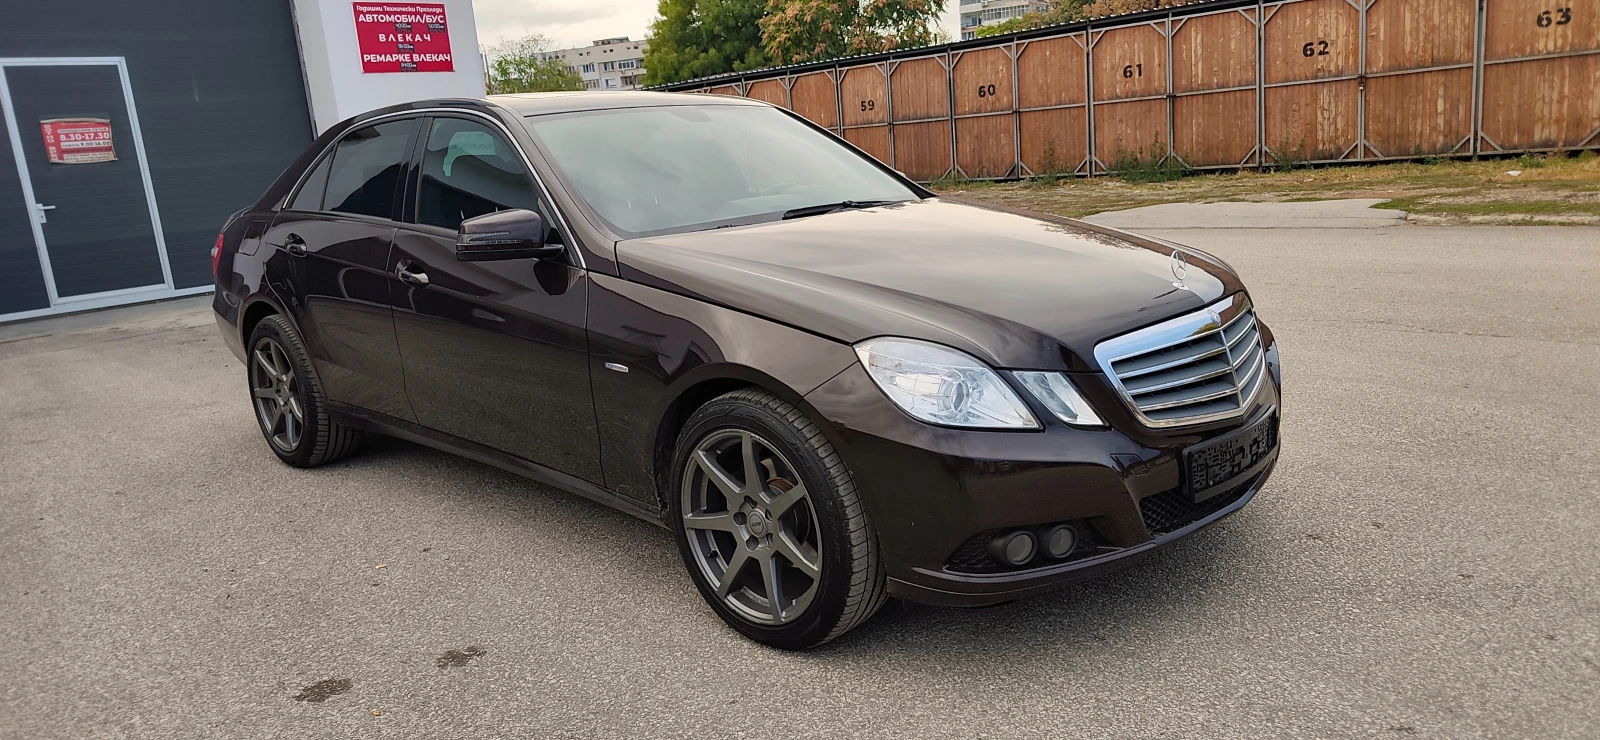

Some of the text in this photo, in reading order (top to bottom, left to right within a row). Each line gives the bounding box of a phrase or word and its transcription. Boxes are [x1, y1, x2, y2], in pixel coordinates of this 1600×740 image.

[358, 14, 445, 23] АВТОМОБИЛ/БУС
[1536, 7, 1571, 27] 63
[1302, 40, 1330, 57] 62
[363, 53, 451, 63] РЕМАРКЕ ВЛЕКАЧ
[1122, 63, 1143, 79] 61
[978, 84, 996, 98] 60
[860, 100, 875, 111] 59
[60, 132, 110, 141] 8.30-17.30
